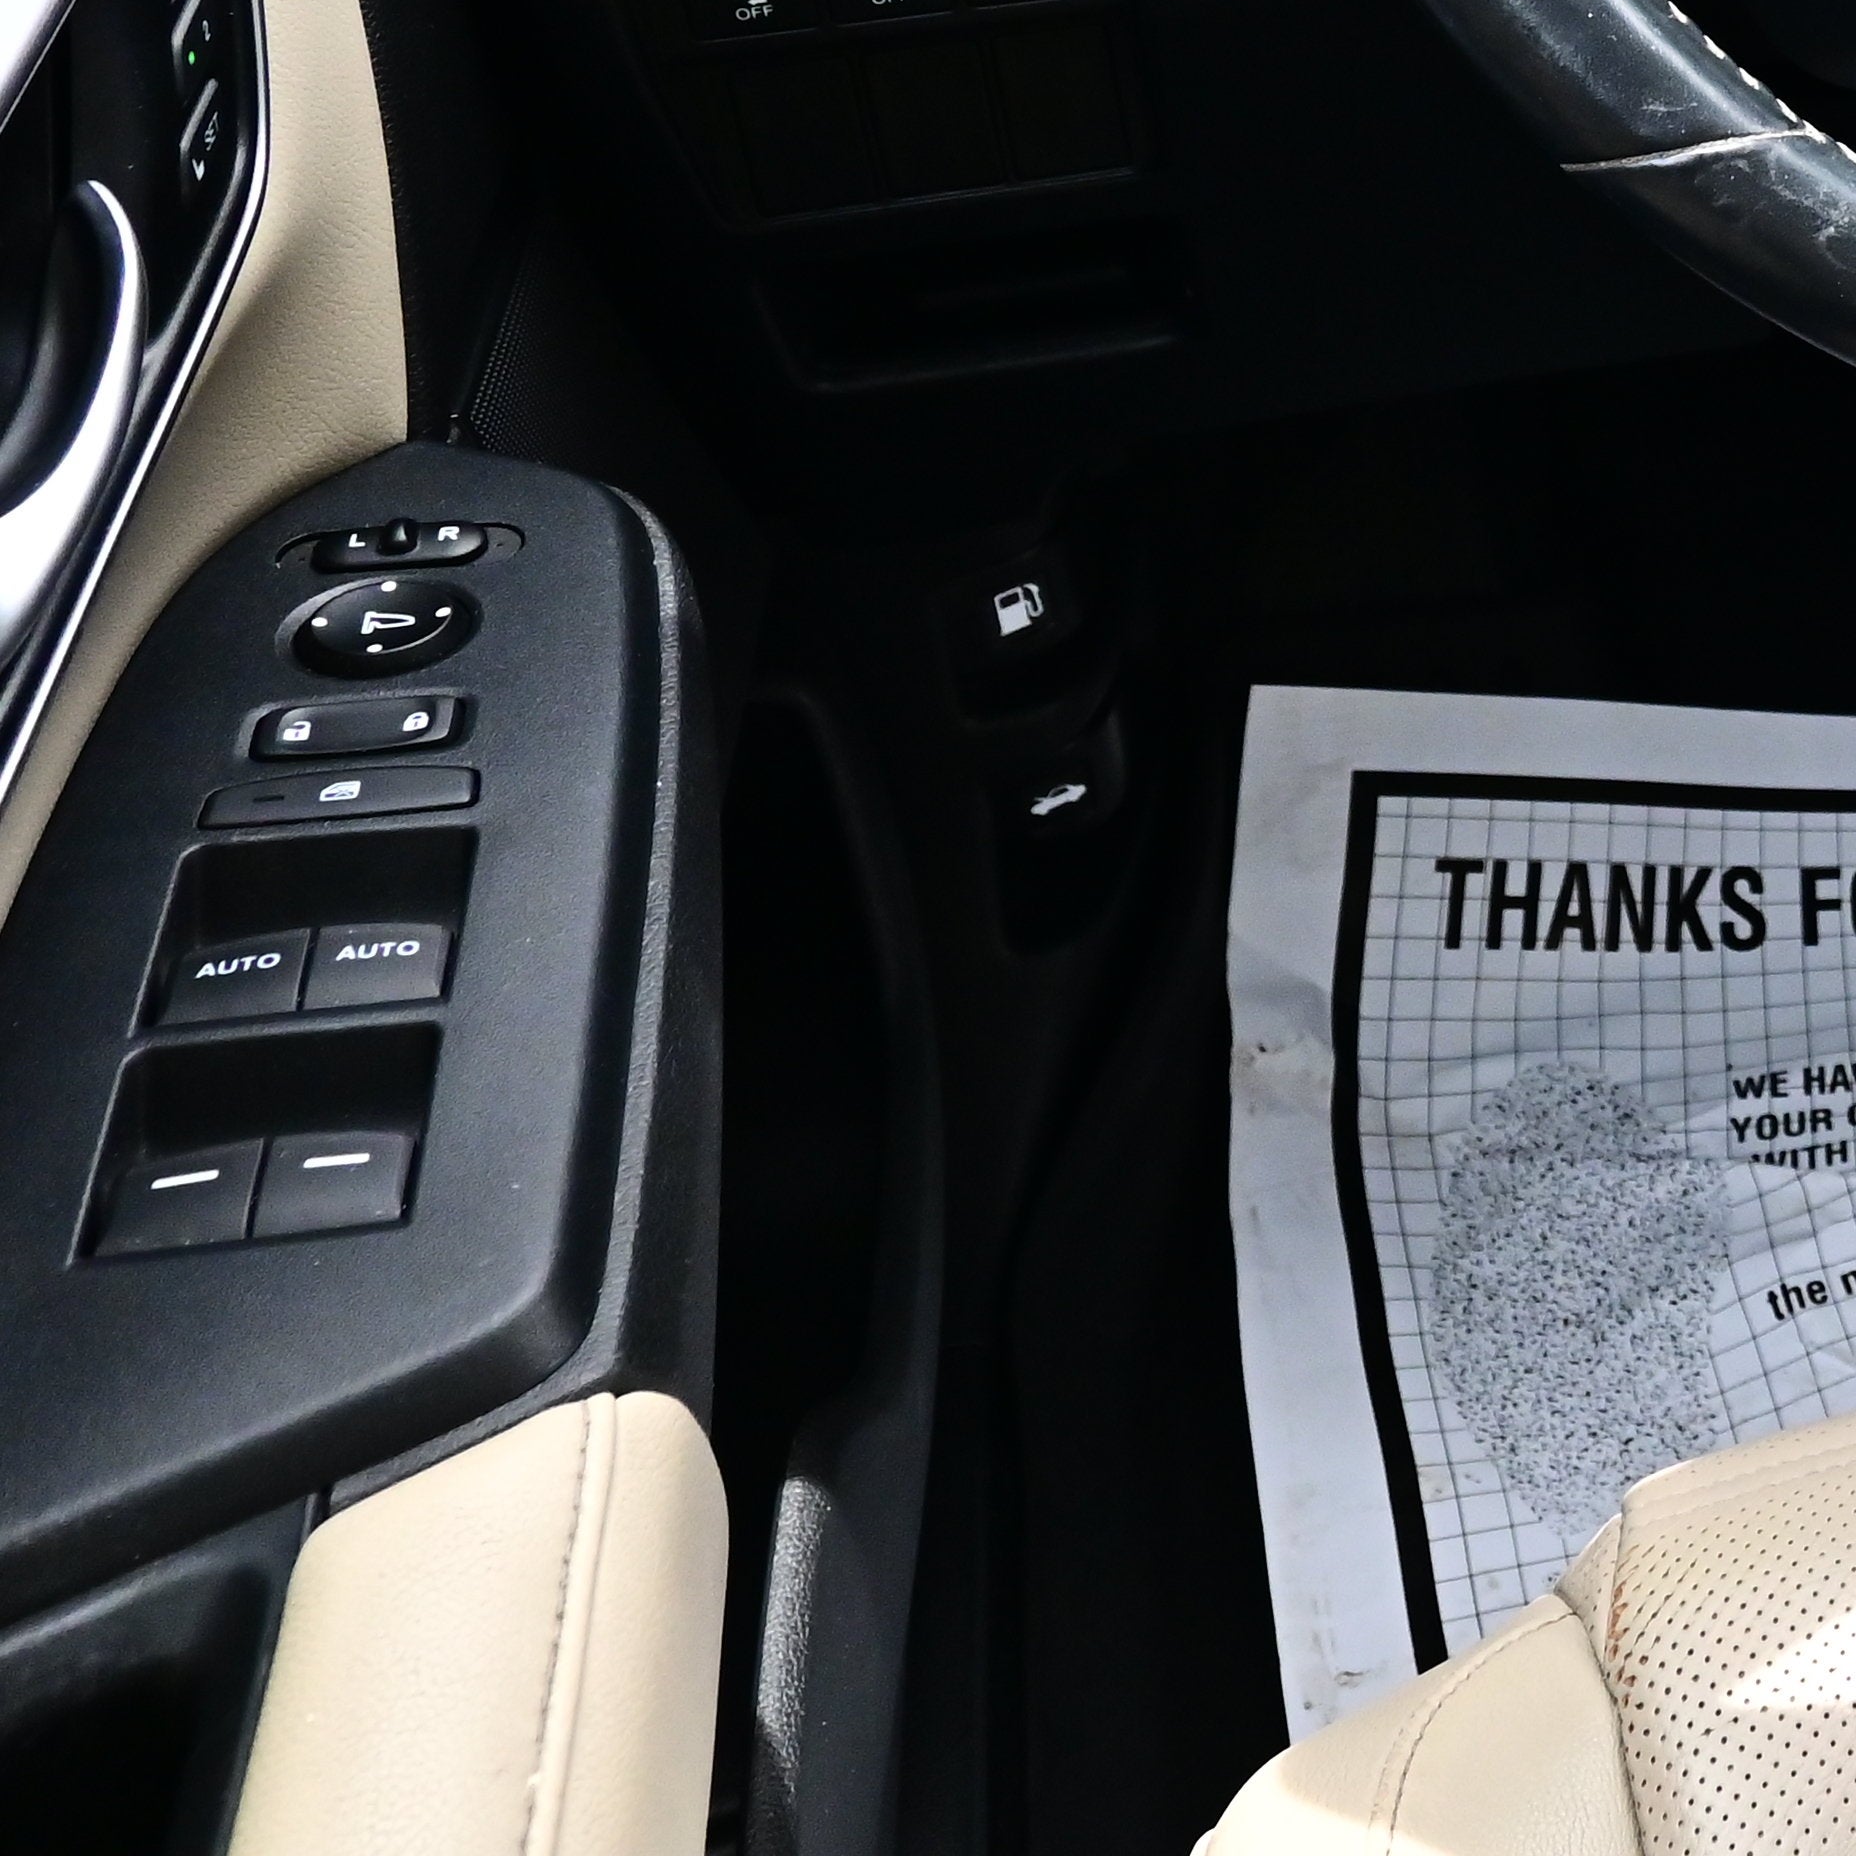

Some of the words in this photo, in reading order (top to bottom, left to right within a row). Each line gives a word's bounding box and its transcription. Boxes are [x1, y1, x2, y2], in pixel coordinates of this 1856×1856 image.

[735, 3, 774, 22] OFF
[348, 533, 366, 548] L
[437, 525, 461, 543] R
[1435, 856, 1767, 954] THANKS
[194, 951, 282, 981] AUTO
[335, 939, 420, 963] AUTO
[1733, 1070, 1789, 1100] WE
[1730, 1107, 1833, 1144] YOUR
[1767, 1280, 1829, 1322] the
